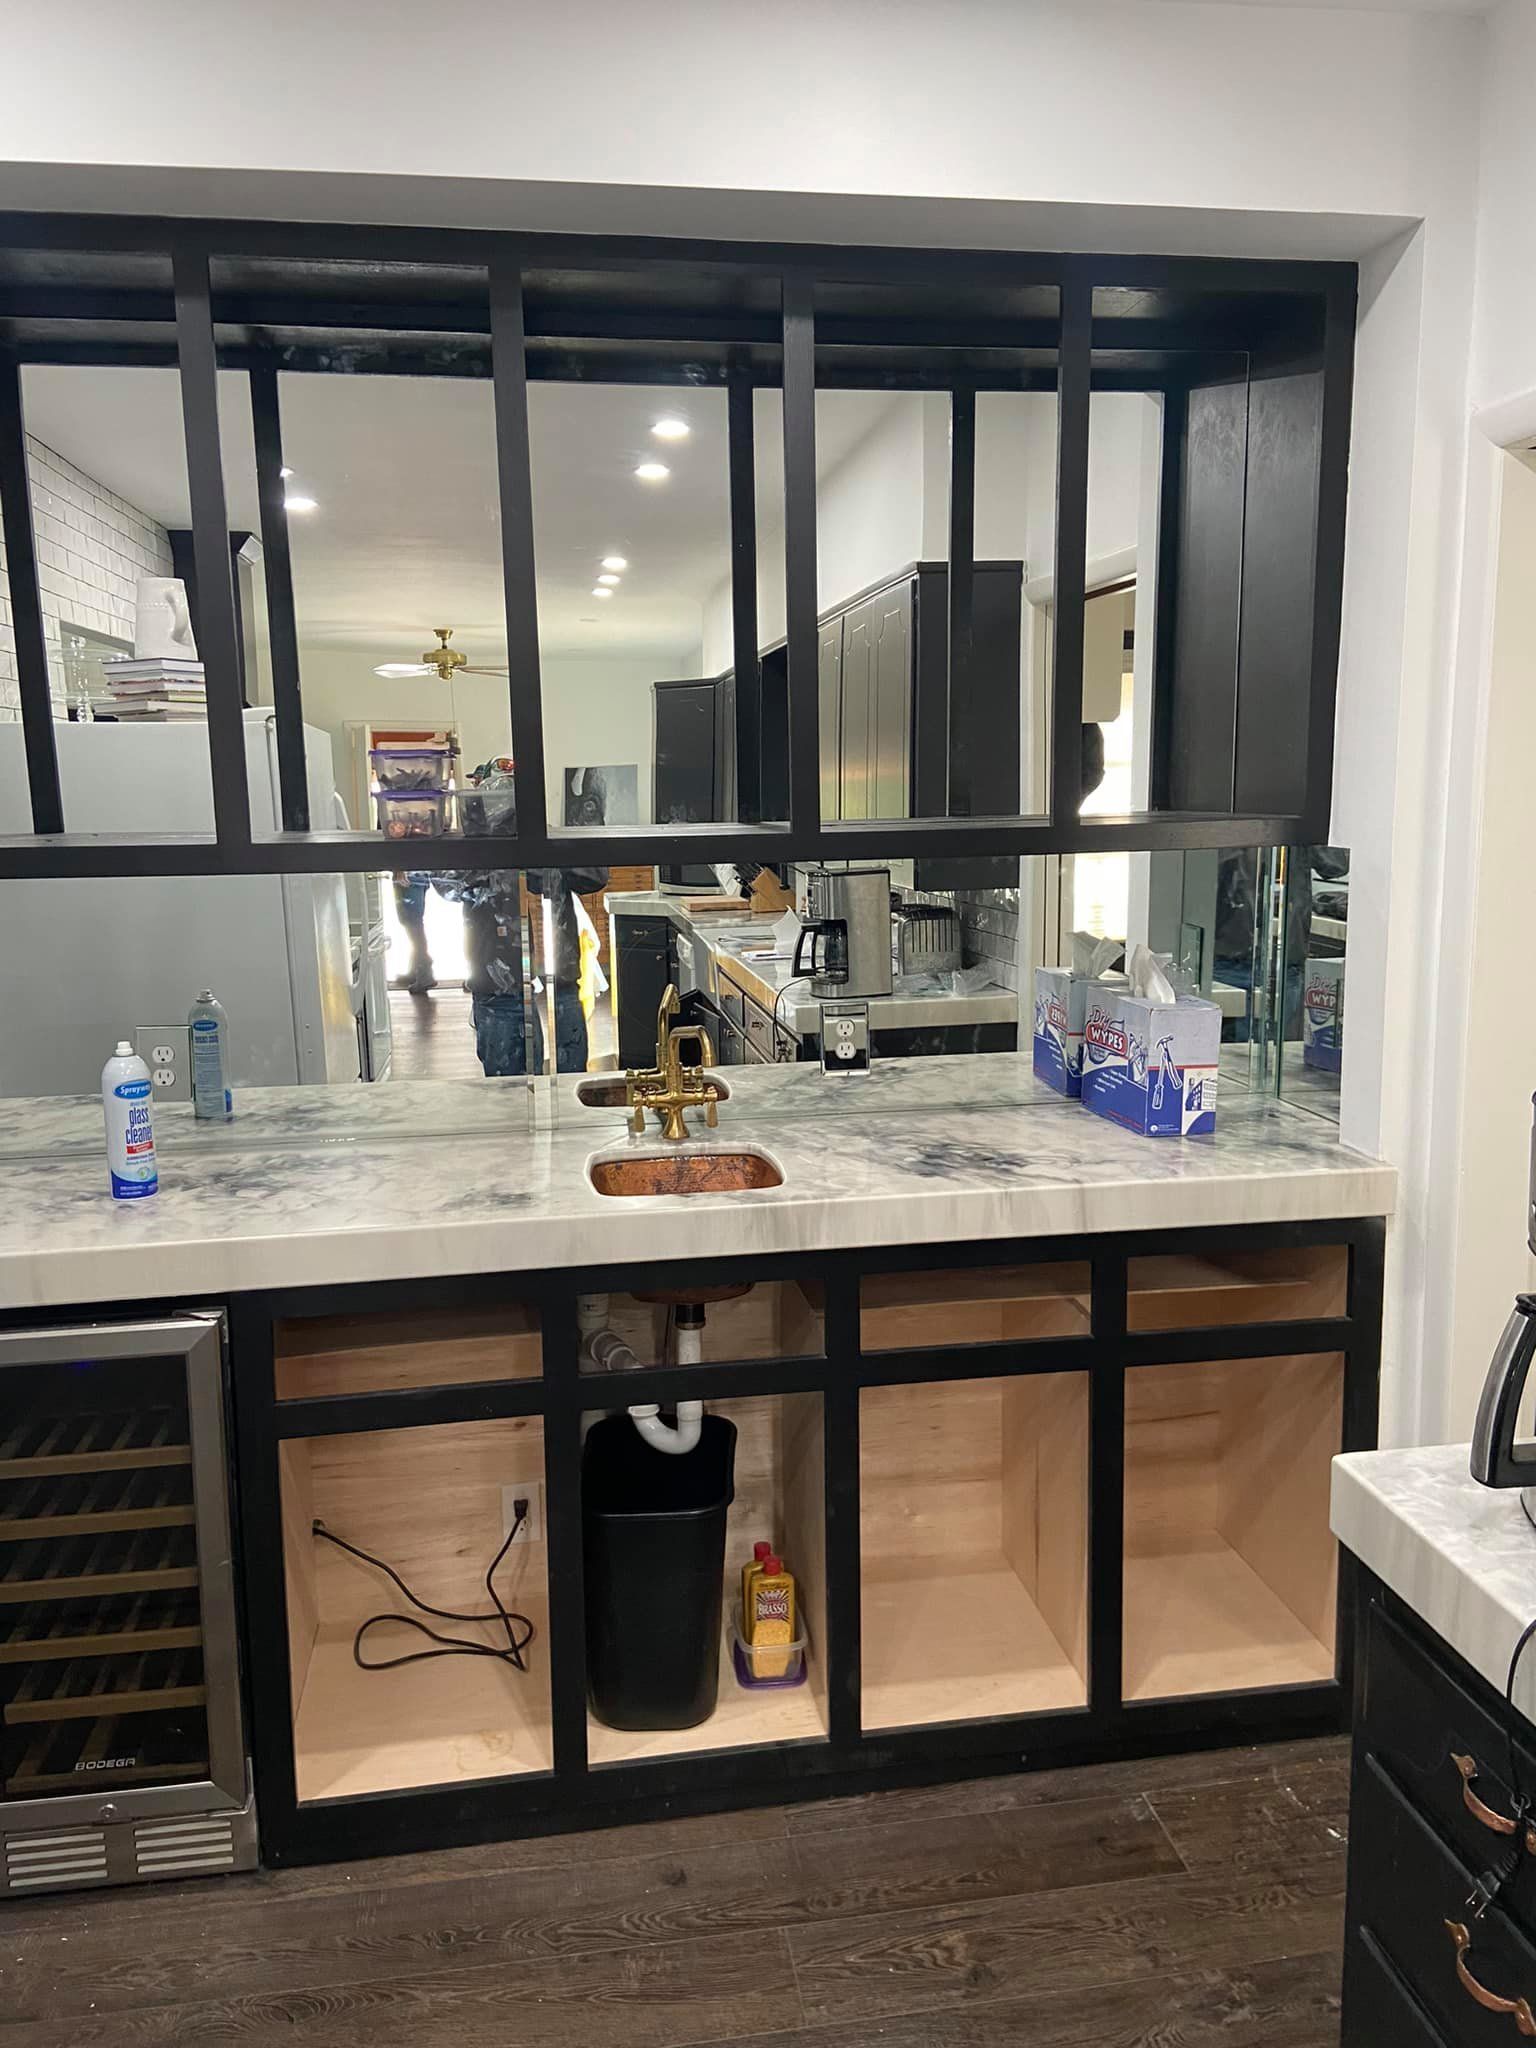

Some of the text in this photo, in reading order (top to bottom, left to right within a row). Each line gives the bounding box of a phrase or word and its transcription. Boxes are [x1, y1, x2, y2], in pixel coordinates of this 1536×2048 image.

[1312, 993, 1336, 1007] WYP
[1091, 1026, 1123, 1050] WYPES
[129, 1108, 149, 1127] glass
[125, 1125, 153, 1144] cleaner
[758, 1603, 787, 1615] BRASSO
[75, 1757, 136, 1771] BODEGA
